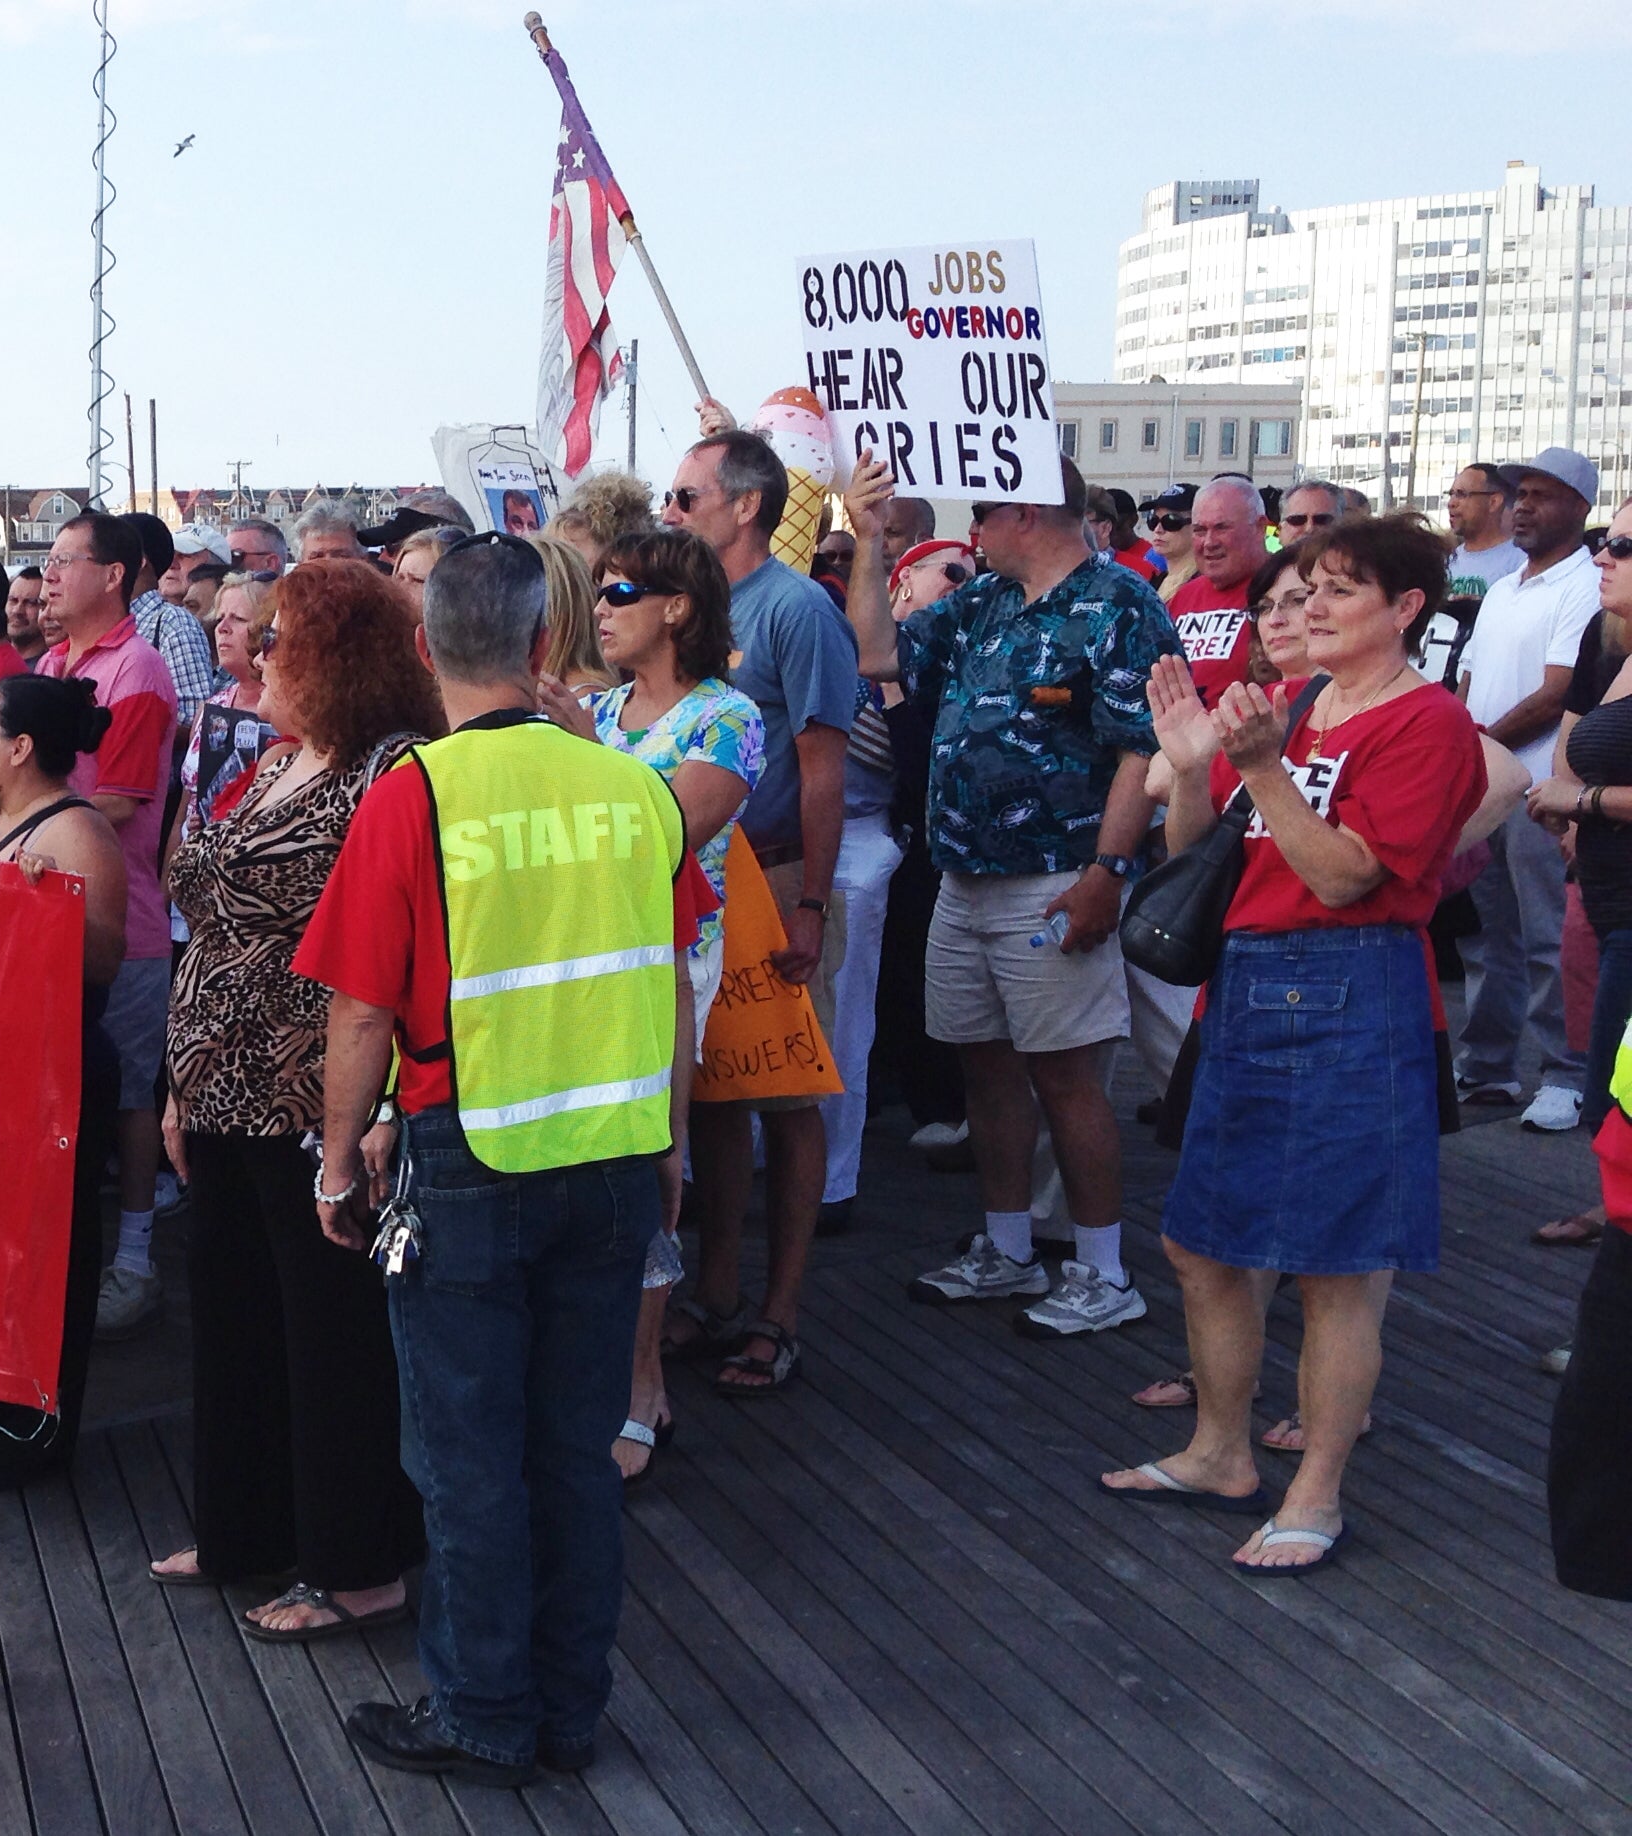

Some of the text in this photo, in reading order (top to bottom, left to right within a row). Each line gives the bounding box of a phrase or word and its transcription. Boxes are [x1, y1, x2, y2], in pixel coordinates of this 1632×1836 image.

[802, 250, 1006, 331] 8,000 JOBS
[907, 305, 1042, 341] GOVERNOR
[806, 347, 1051, 421] HEAR OUR
[854, 421, 1024, 493] CRIES
[442, 802, 643, 881] STAFF
